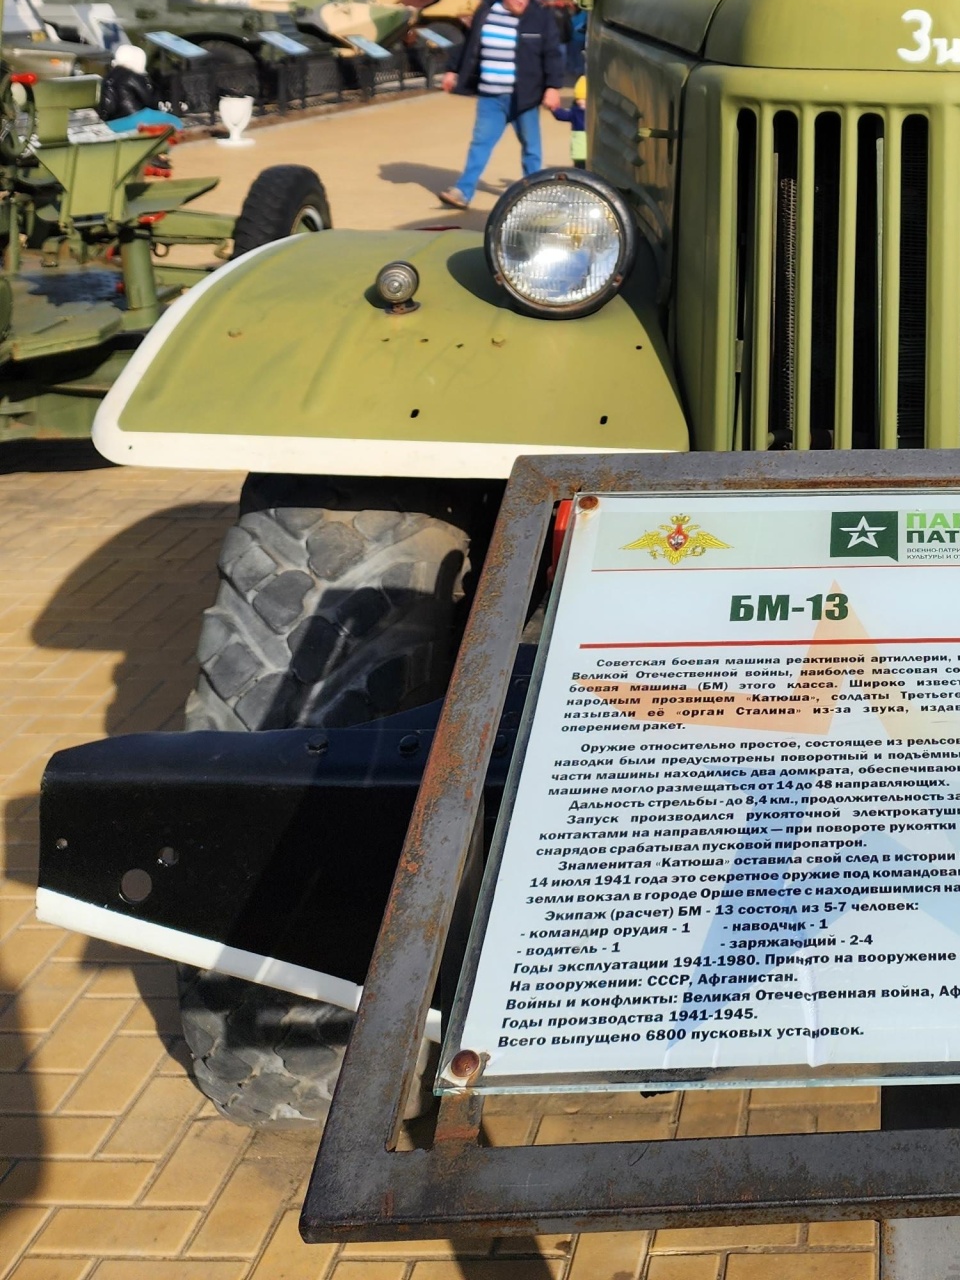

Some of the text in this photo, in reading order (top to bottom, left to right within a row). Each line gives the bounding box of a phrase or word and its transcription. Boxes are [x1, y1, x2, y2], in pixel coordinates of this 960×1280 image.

[729, 593, 849, 622] БМ-13
[596, 659, 666, 668] Советская
[671, 657, 720, 666] боевая
[725, 657, 781, 665] машина
[786, 653, 865, 666] реактивной
[870, 655, 952, 665] артиллерии,
[571, 670, 629, 681] Великой
[635, 668, 738, 679] Отечественной
[745, 667, 793, 678] войны,
[800, 666, 865, 677] наиболее
[871, 667, 938, 675] массовая
[568, 681, 620, 693] боевая
[629, 684, 687, 692] машина
[697, 681, 729, 693] (БМ)
[738, 682, 777, 690] этого
[786, 681, 838, 689] класса.
[849, 679, 906, 692] Широко
[566, 695, 641, 708] народным
[651, 695, 735, 706] прозвищем
[746, 693, 820, 704] «Катюша»,
[830, 693, 890, 702] солдаты
[563, 710, 636, 719] называли
[647, 707, 665, 717] её
[676, 708, 725, 718] «орган
[735, 706, 801, 716] Сталина»
[812, 706, 852, 715] из-за
[862, 703, 909, 715] звука,
[561, 722, 686, 734] оперением ракет.
[553, 758, 614, 768] наводки
[618, 755, 656, 766] были
[661, 755, 775, 766] предусмотрены
[780, 753, 868, 763] поворотный
[873, 752, 883, 760] и
[548, 779, 950, 796] машине могло размещаться от 14 до 48 направляющих.
[566, 814, 619, 826] Запуск
[630, 812, 734, 825] производился
[745, 810, 841, 822] рукояточной
[529, 877, 549, 888] 14
[551, 878, 592, 888] июля
[594, 874, 632, 886] 1941
[634, 875, 668, 886] года
[670, 874, 697, 884] это
[699, 872, 780, 884] секретное
[781, 870, 840, 882] оружие
[843, 870, 871, 880] под
[526, 895, 574, 904] земли
[576, 893, 631, 903] вокзал
[632, 892, 642, 901] в
[644, 890, 698, 902] городе
[700, 887, 744, 901] Орше
[746, 887, 802, 897] вместе
[804, 887, 813, 896] с
[815, 884, 941, 896] находившимися
[513, 962, 553, 975] Годы
[557, 959, 669, 974] эксплуатации
[673, 954, 760, 968] 1941-1980.
[764, 953, 830, 967] Принято
[834, 954, 853, 963] на
[857, 952, 957, 965] вооружение
[509, 972, 798, 993] На вооружении: СССР, Афганистан.
[505, 996, 562, 1011] Войны
[565, 998, 577, 1008] и
[580, 994, 678, 1009] конфликты:
[682, 991, 751, 1004] Великая
[755, 989, 876, 1002] Отечественная
[881, 985, 935, 999] война,
[501, 1007, 758, 1030] Годы производства 1941-1945.
[497, 1026, 864, 1048] Всего выпущено 6800 пусковых установок.
